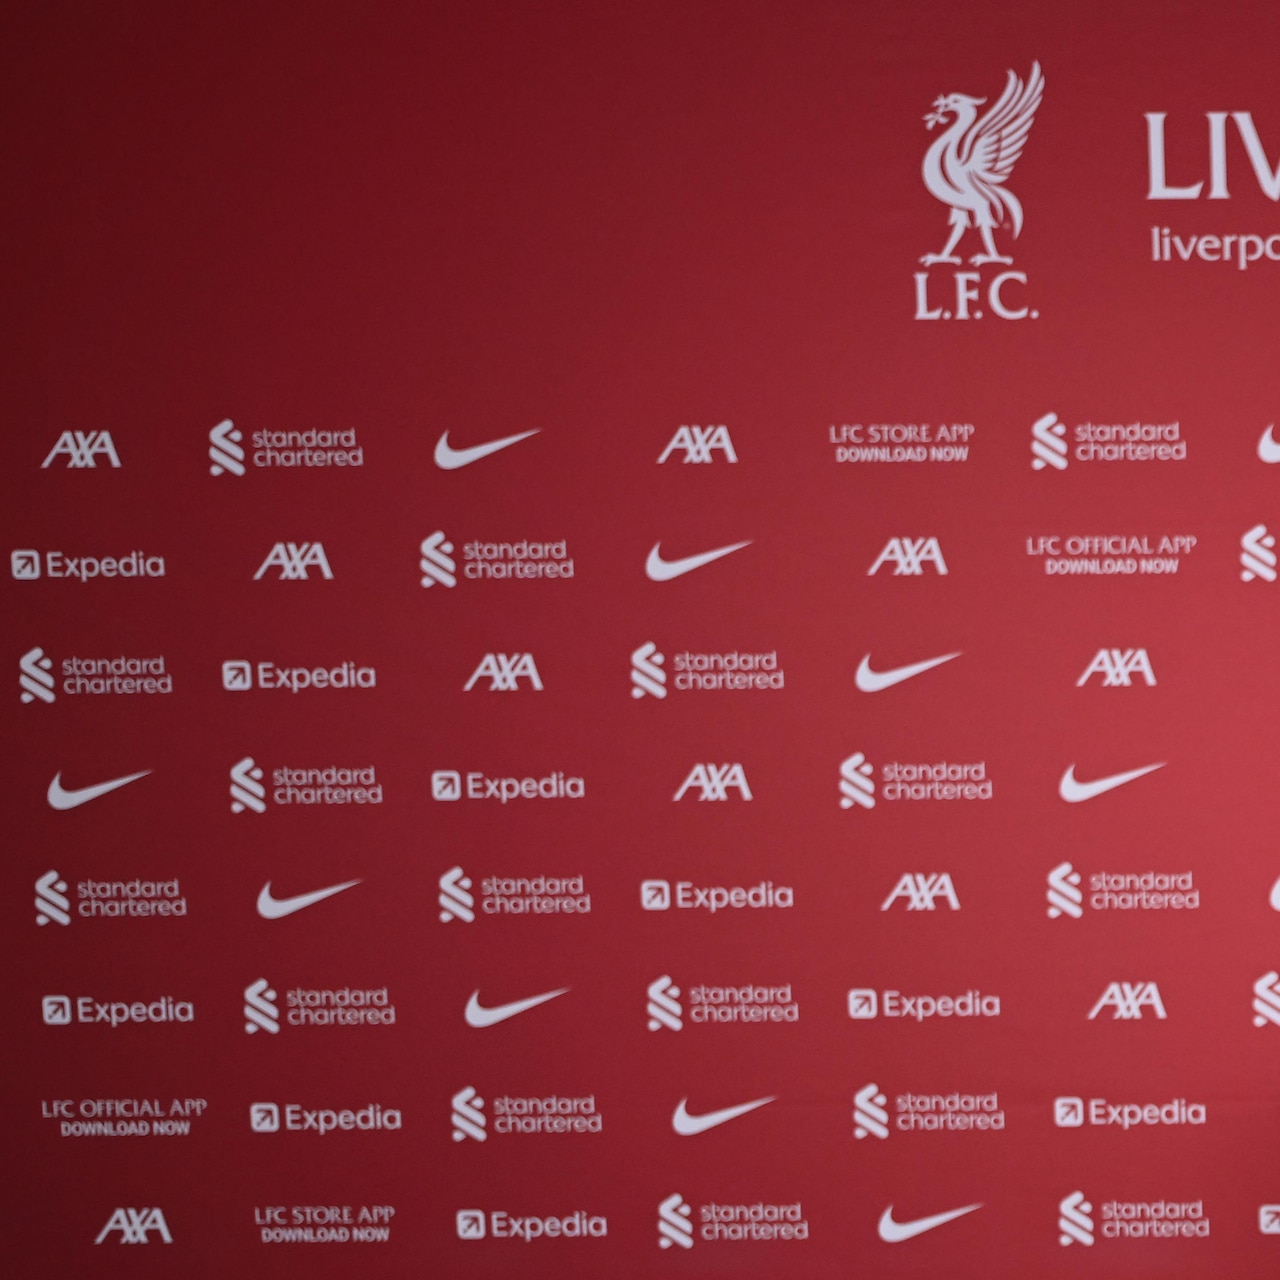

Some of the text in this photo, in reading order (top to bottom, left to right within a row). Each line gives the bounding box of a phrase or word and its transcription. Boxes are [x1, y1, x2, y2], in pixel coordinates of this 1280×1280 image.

[914, 272, 1040, 321] L.F.C.
[251, 427, 358, 448] standard
[657, 425, 738, 464] AXA
[829, 423, 975, 444] LFC STORE APP
[1074, 421, 1181, 442] standard
[41, 430, 122, 469] AXA
[253, 447, 364, 468] chartered
[835, 445, 970, 463] DOWNLOAD NOW
[1075, 441, 1187, 462] chartered
[46, 550, 166, 583] Expedia
[253, 542, 334, 581] AXA
[867, 537, 949, 576] AXA
[463, 652, 544, 692] AXA
[673, 650, 779, 671] standard
[1076, 648, 1157, 687] AXA
[257, 661, 377, 694] Expedia
[674, 670, 785, 690] chartered
[466, 771, 586, 804] Expedia
[673, 763, 753, 802] AXA
[77, 878, 182, 898] standard
[675, 881, 794, 913] Expedia
[78, 897, 188, 917] chartered
[689, 984, 794, 1004] standard
[882, 990, 1001, 1022] Expedia
[76, 996, 195, 1028] Expedia
[690, 1003, 800, 1023] chartered
[41, 1098, 208, 1118] LFC OFFICIAL APP
[284, 1103, 402, 1136] Expedia
[60, 1119, 191, 1137] DOWNLOAD NOW
[95, 1207, 173, 1245] AXA
[490, 1210, 608, 1242] Expedia
